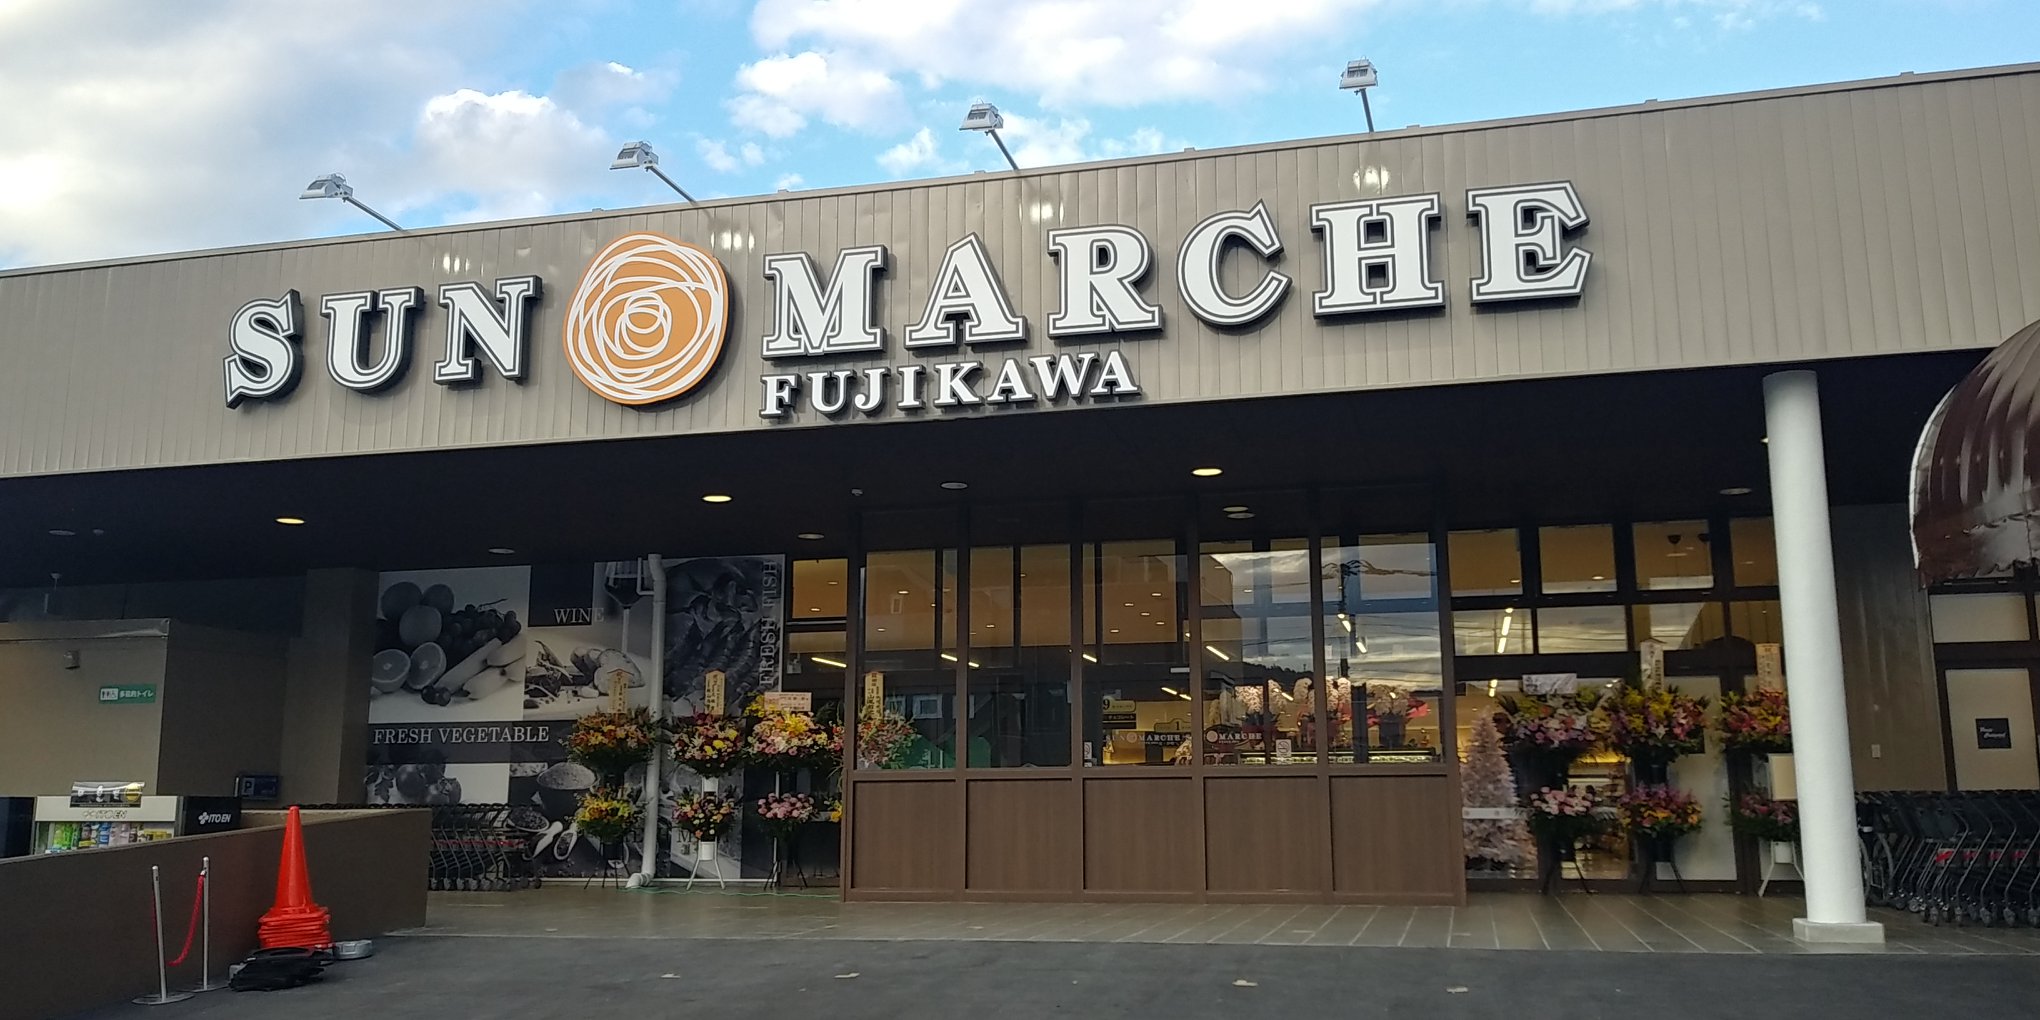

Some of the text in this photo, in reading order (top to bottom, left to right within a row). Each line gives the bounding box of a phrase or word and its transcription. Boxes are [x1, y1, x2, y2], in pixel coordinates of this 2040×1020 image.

[222, 179, 1593, 409] SUN MARCHE
[759, 349, 1143, 419] FUJIKAWA
[553, 606, 605, 625] WINE
[758, 560, 778, 687] FRESH FISH
[373, 726, 549, 745] FRESH VEGETABLE
[1138, 734, 1181, 742] MARCHE
[1219, 732, 1262, 741] MARCHE
